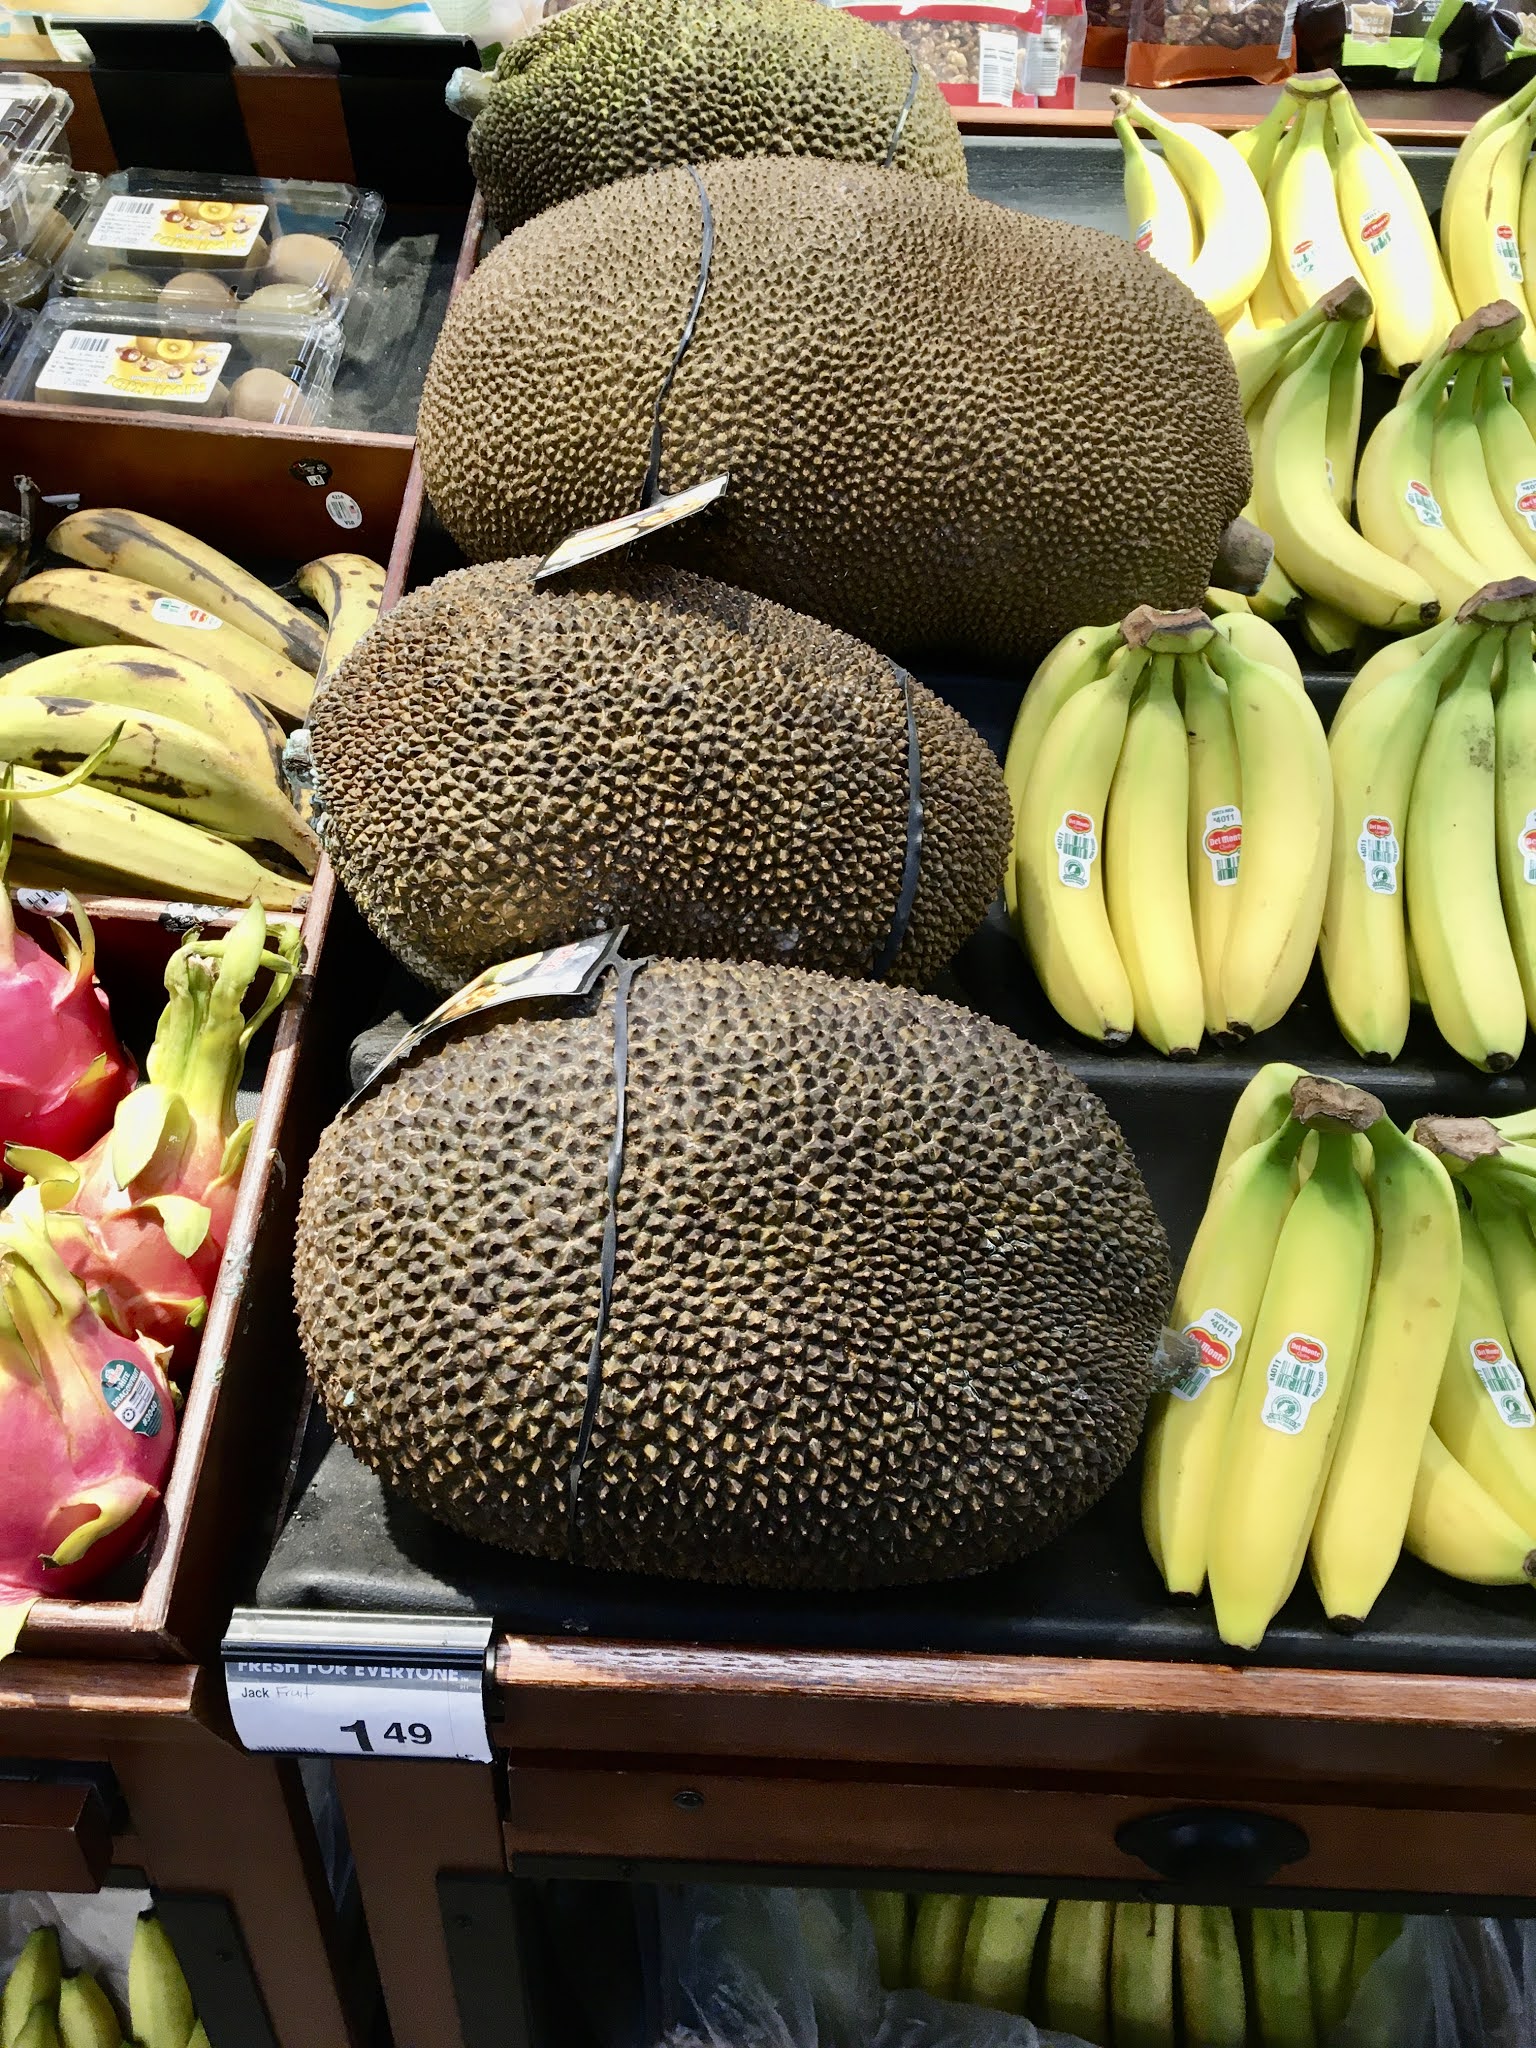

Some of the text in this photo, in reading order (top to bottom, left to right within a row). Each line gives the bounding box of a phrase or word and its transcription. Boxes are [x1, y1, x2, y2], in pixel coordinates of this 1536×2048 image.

[1209, 837, 1221, 846] Del
[1213, 1311, 1238, 1331] COSTA RICA
[1200, 1341, 1227, 1364] Monte
[1291, 1342, 1320, 1358] Del Monte
[238, 1662, 299, 1674] FRESH
[307, 1664, 347, 1676] FOR
[241, 1686, 269, 1698] Jack
